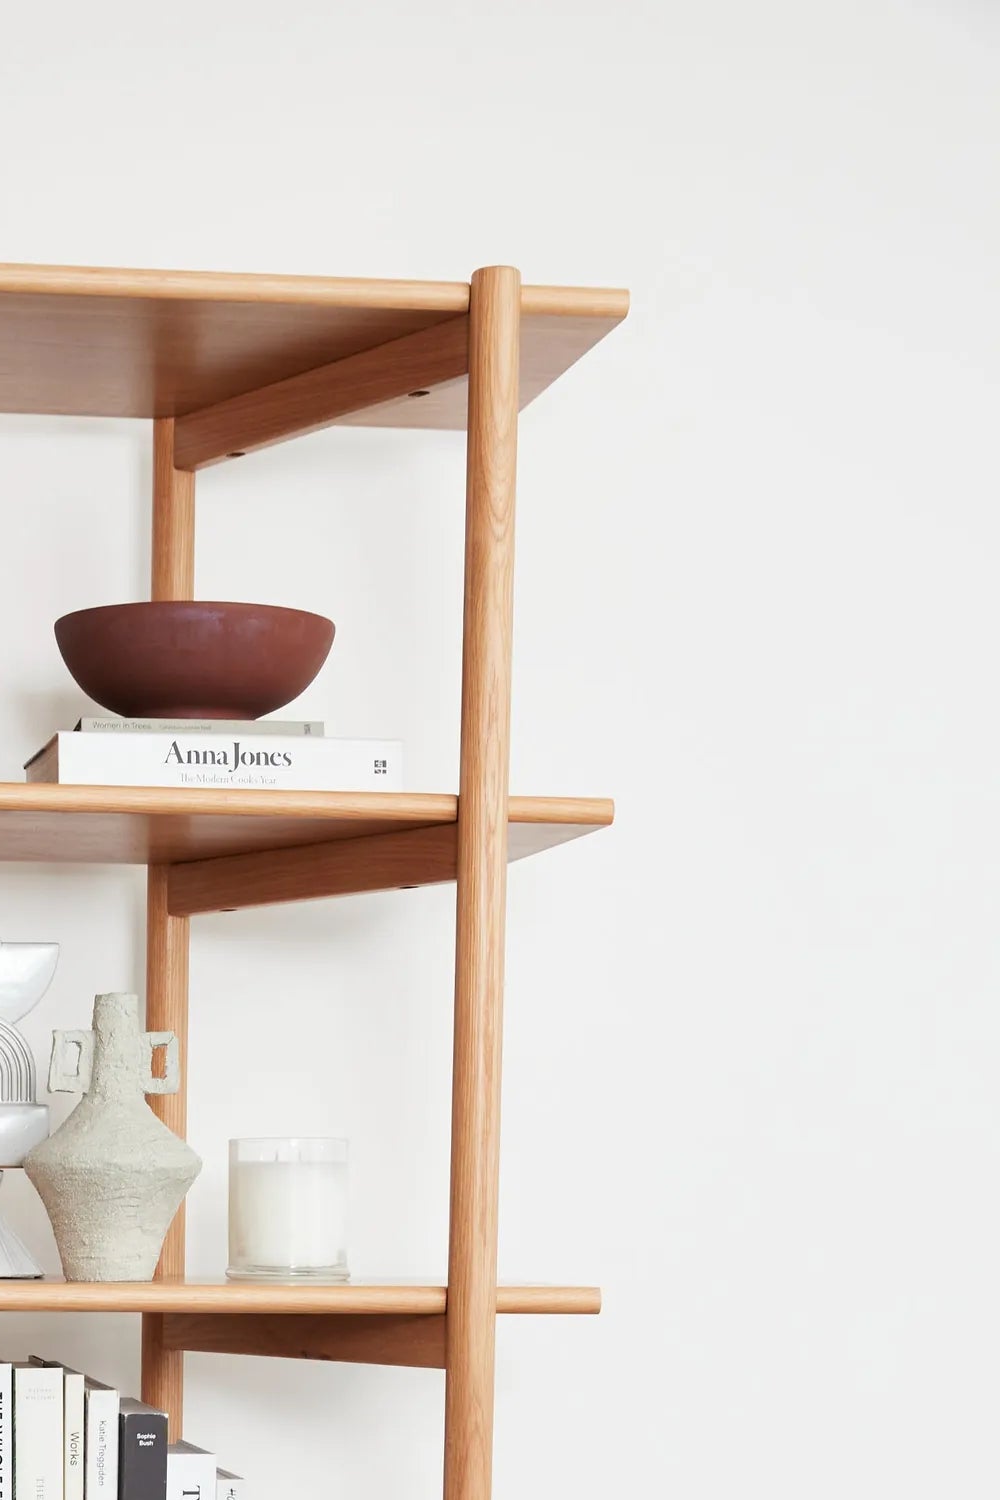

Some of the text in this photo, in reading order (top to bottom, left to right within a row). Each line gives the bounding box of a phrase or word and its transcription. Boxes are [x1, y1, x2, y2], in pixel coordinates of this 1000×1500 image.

[165, 740, 293, 773] Anna Jones
[197, 774, 229, 784] Modern
[98, 1420, 107, 1441] Katie
[69, 1431, 80, 1466] Works
